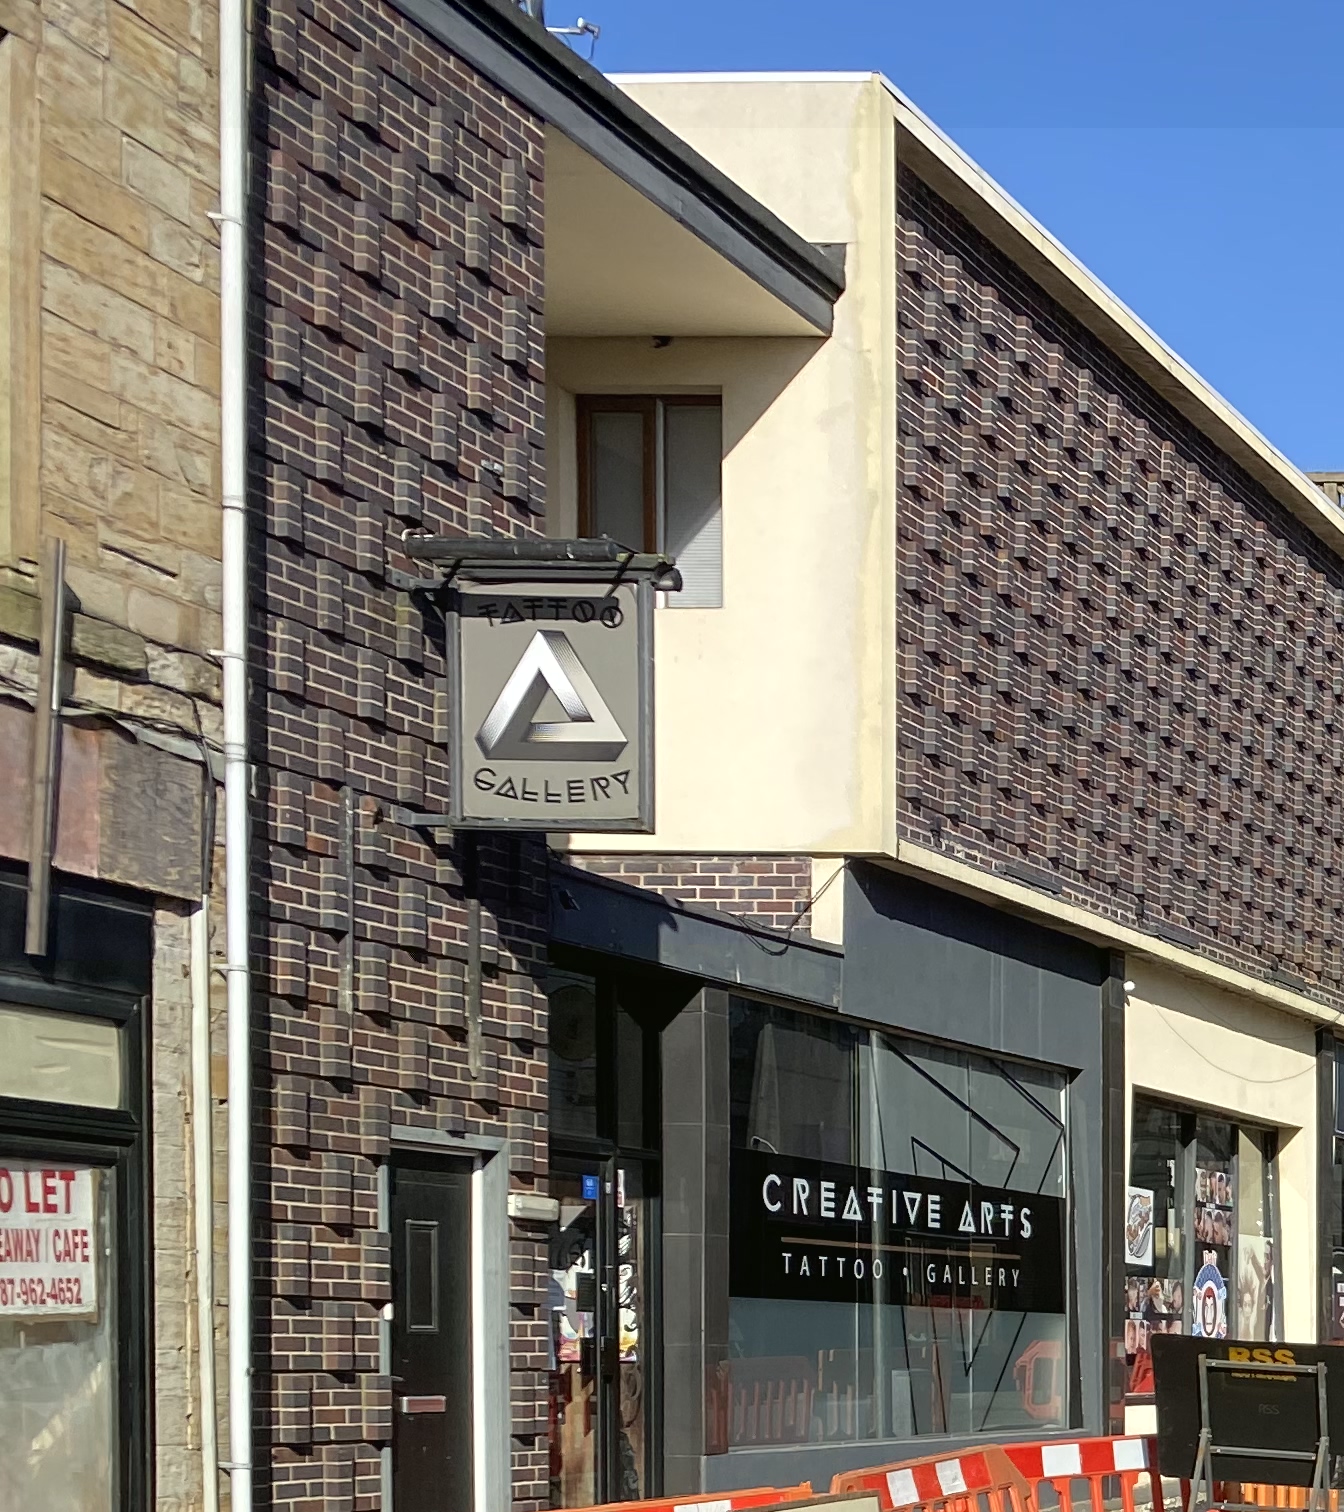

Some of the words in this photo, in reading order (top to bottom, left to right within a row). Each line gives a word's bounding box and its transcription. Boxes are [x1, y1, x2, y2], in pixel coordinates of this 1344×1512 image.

[477, 600, 624, 629] TATTOO
[473, 767, 631, 804] GALLERY
[0, 1167, 14, 1213] O
[23, 1168, 76, 1214] LET
[762, 1174, 941, 1229] CREATIVE
[958, 1200, 1033, 1239] ARTS
[0, 1228, 40, 1263] AWAY
[52, 1228, 90, 1263] CAFE
[781, 1252, 884, 1280] TATTOO
[926, 1263, 1021, 1288] GALLERY
[1228, 1346, 1297, 1367] RSS
